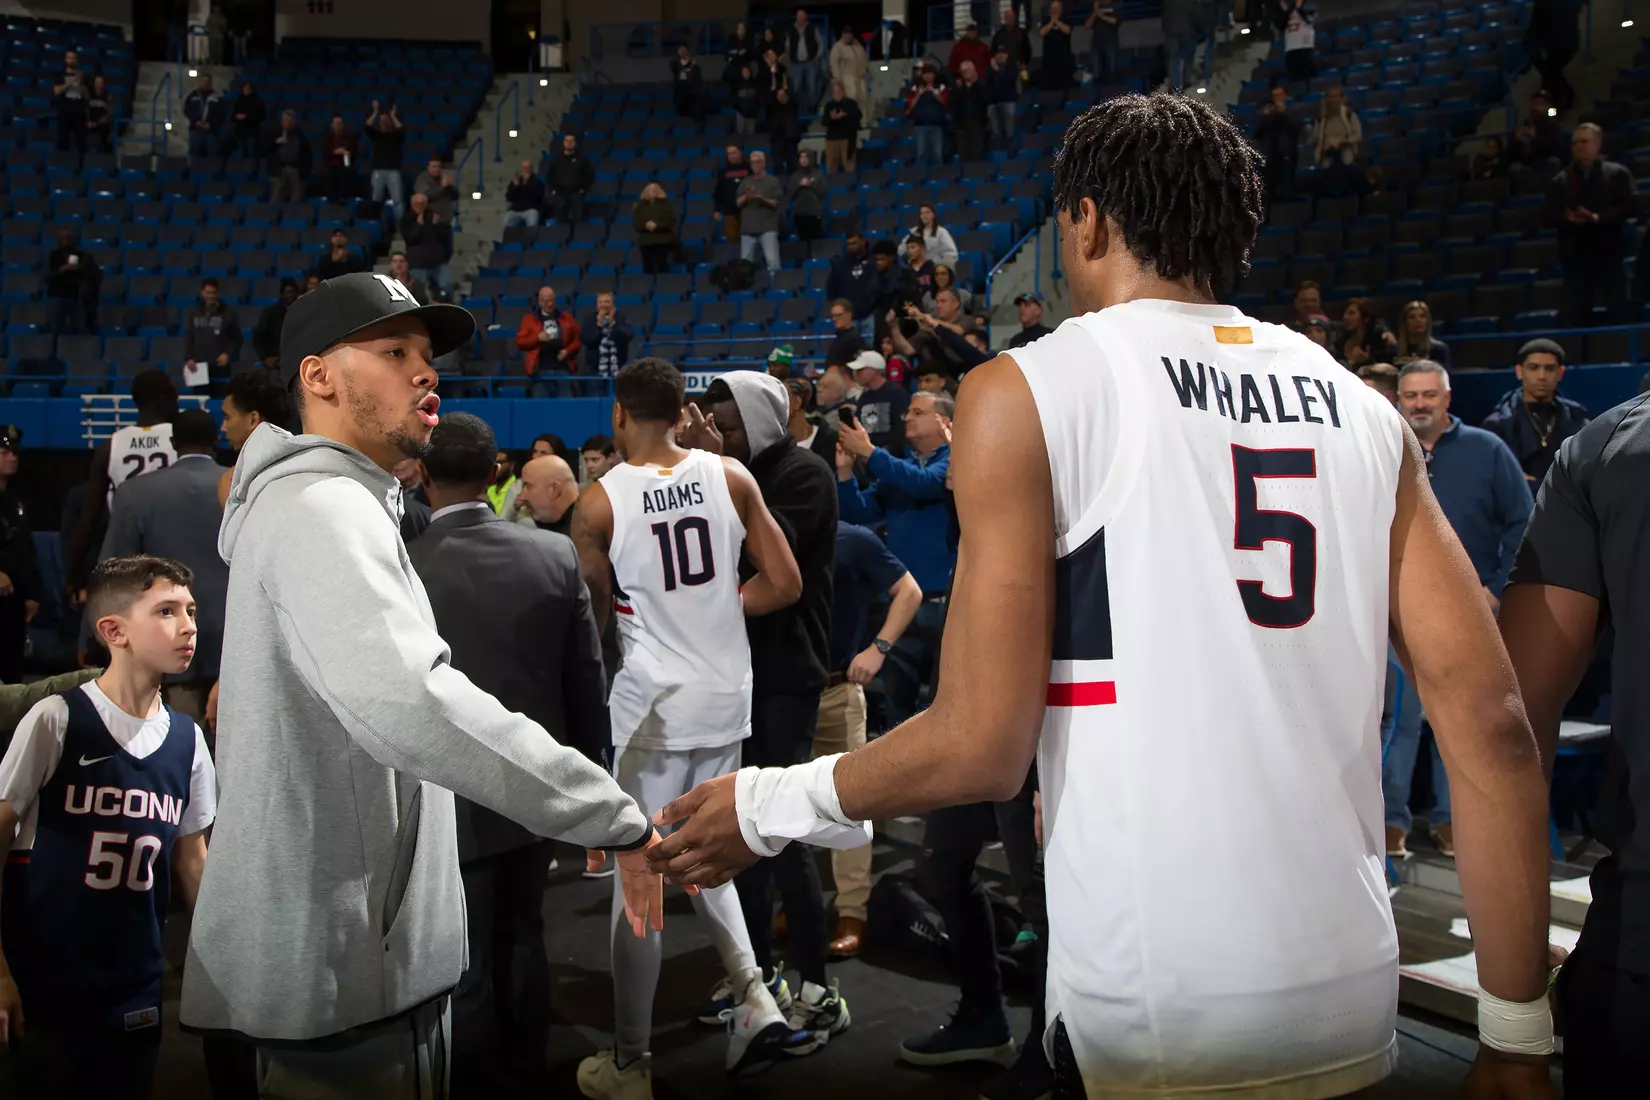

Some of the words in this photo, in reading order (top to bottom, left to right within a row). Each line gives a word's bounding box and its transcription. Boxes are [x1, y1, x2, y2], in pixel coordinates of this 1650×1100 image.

[1160, 356, 1342, 428] WHALEY
[130, 436, 160, 449] AKOK
[643, 481, 704, 514] ADAMS
[651, 515, 716, 592] 10
[1230, 443, 1317, 629] 5
[64, 784, 183, 826] UCONN
[84, 830, 162, 892] 50
